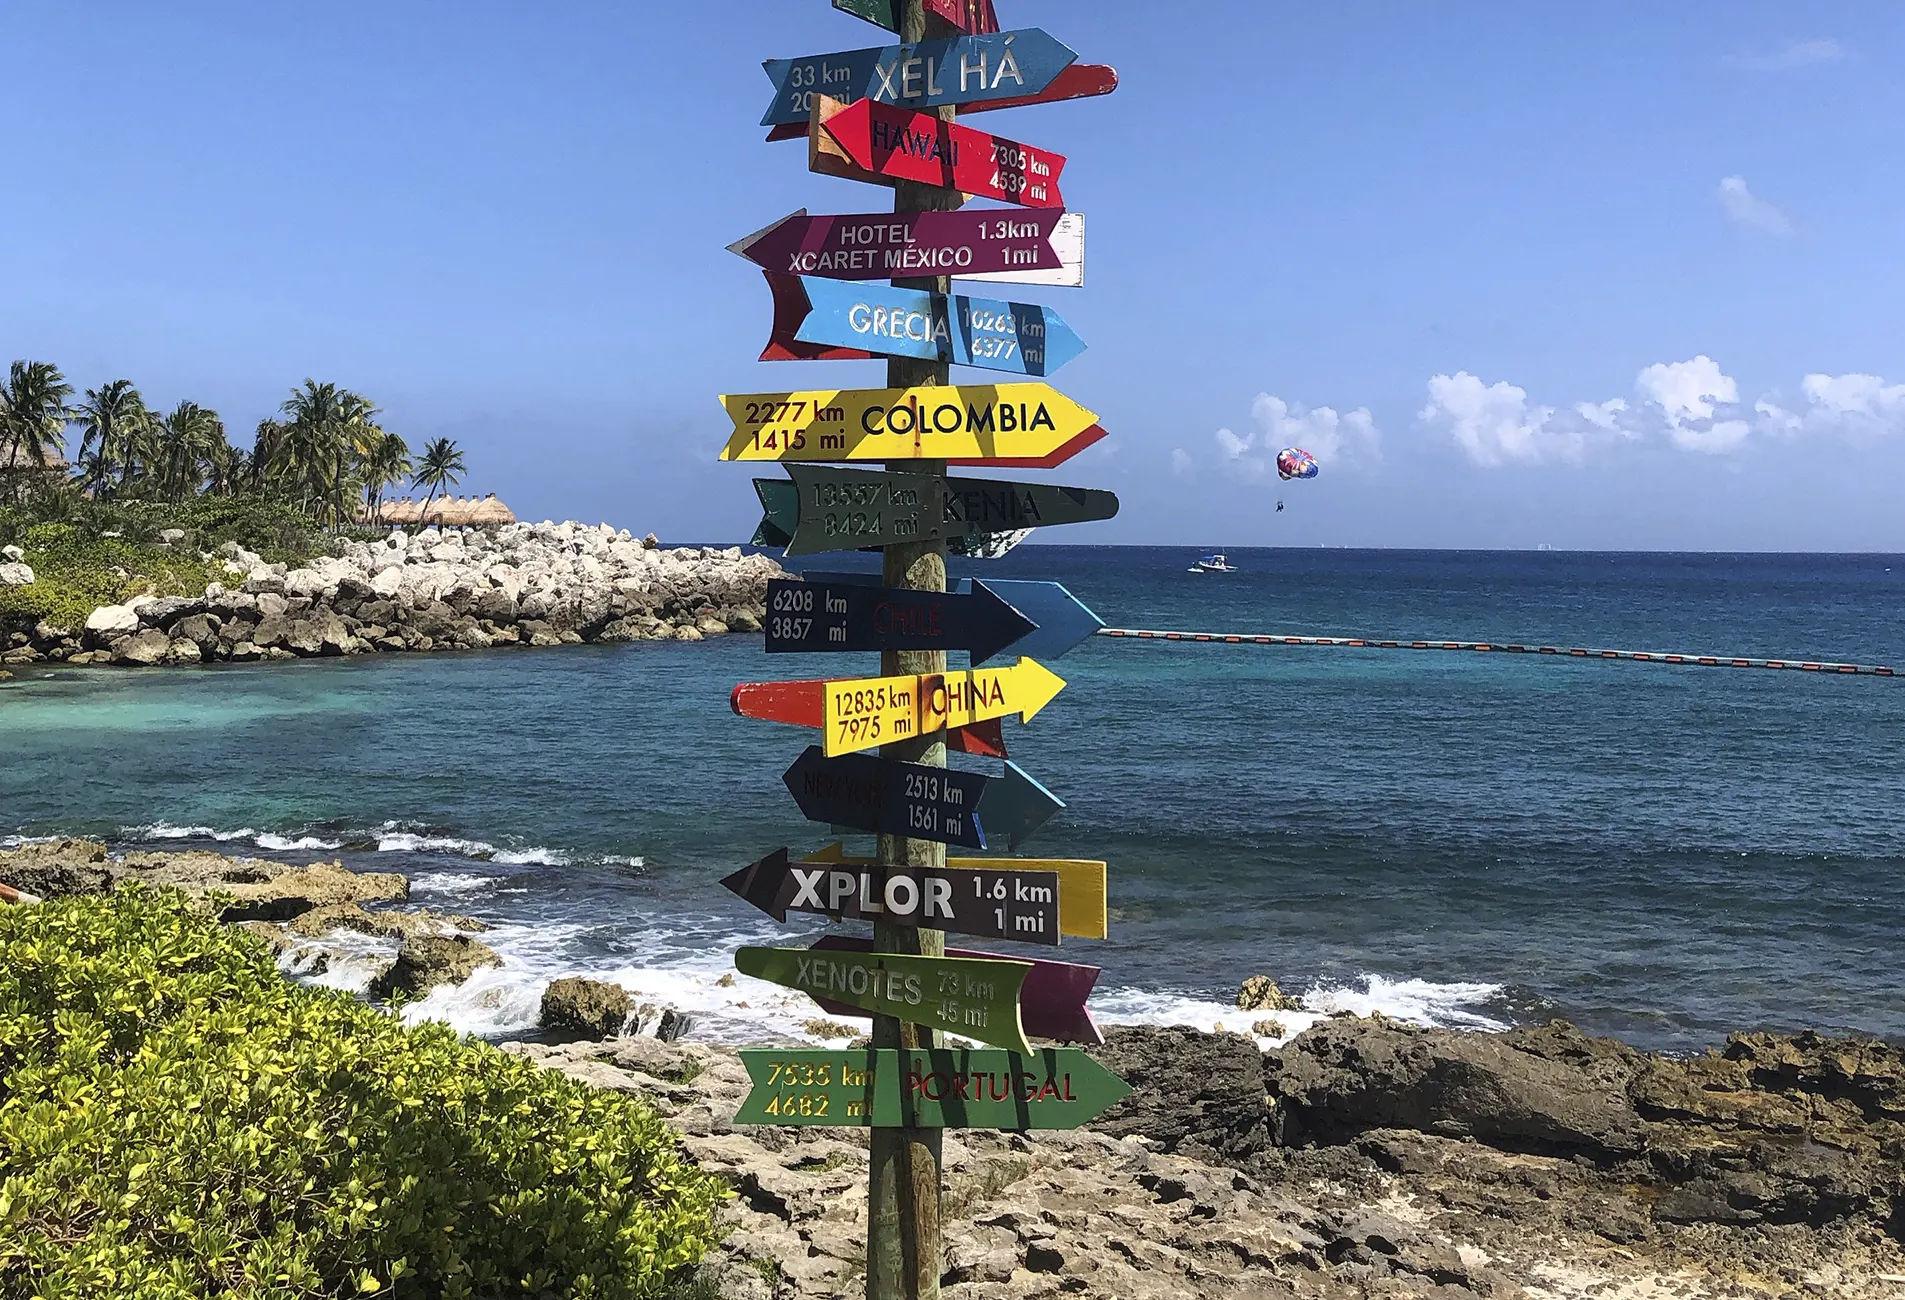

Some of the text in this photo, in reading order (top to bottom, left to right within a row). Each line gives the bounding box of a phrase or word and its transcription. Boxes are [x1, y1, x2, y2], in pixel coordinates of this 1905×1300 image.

[791, 61, 850, 88] 33 km
[873, 35, 1025, 101] XEL HÁ
[873, 119, 957, 167] HAWAII
[989, 142, 1049, 177] 7305 km
[988, 169, 1047, 202] 4539 mi
[841, 224, 916, 246] HOTEL
[978, 220, 1039, 241] 1.3km
[788, 244, 973, 272] XCARET MÉXICO
[848, 303, 949, 343] GRECIA
[964, 305, 1044, 338] 10263 km
[971, 336, 1043, 364] 6377 mi
[745, 400, 844, 424] 2277 km
[861, 403, 1056, 435] COLOMBIA
[751, 429, 845, 451] 1415 mi
[813, 481, 919, 507] 13557 km
[941, 490, 1041, 523] KENIA
[824, 511, 919, 537] 8424 mi
[772, 588, 847, 614] 6208 km
[771, 617, 846, 642] 3857 mi
[872, 601, 944, 637] CHILE
[835, 684, 911, 718] 12835 km
[930, 675, 1005, 717] CHINA
[838, 711, 911, 745] 7975 mi
[904, 772, 963, 805] 2513 km
[908, 803, 962, 836] 1561 mi
[789, 867, 956, 919] XPLOR
[973, 876, 1052, 904] 1.6 km
[994, 908, 1044, 933] 1 mi
[796, 956, 922, 1005] XENOTES
[964, 974, 994, 1000] km
[936, 998, 989, 1028] 45 mi
[767, 1060, 875, 1086] 7535 km
[906, 1071, 1077, 1103] PORTUGAL
[764, 1091, 829, 1117] 4682
